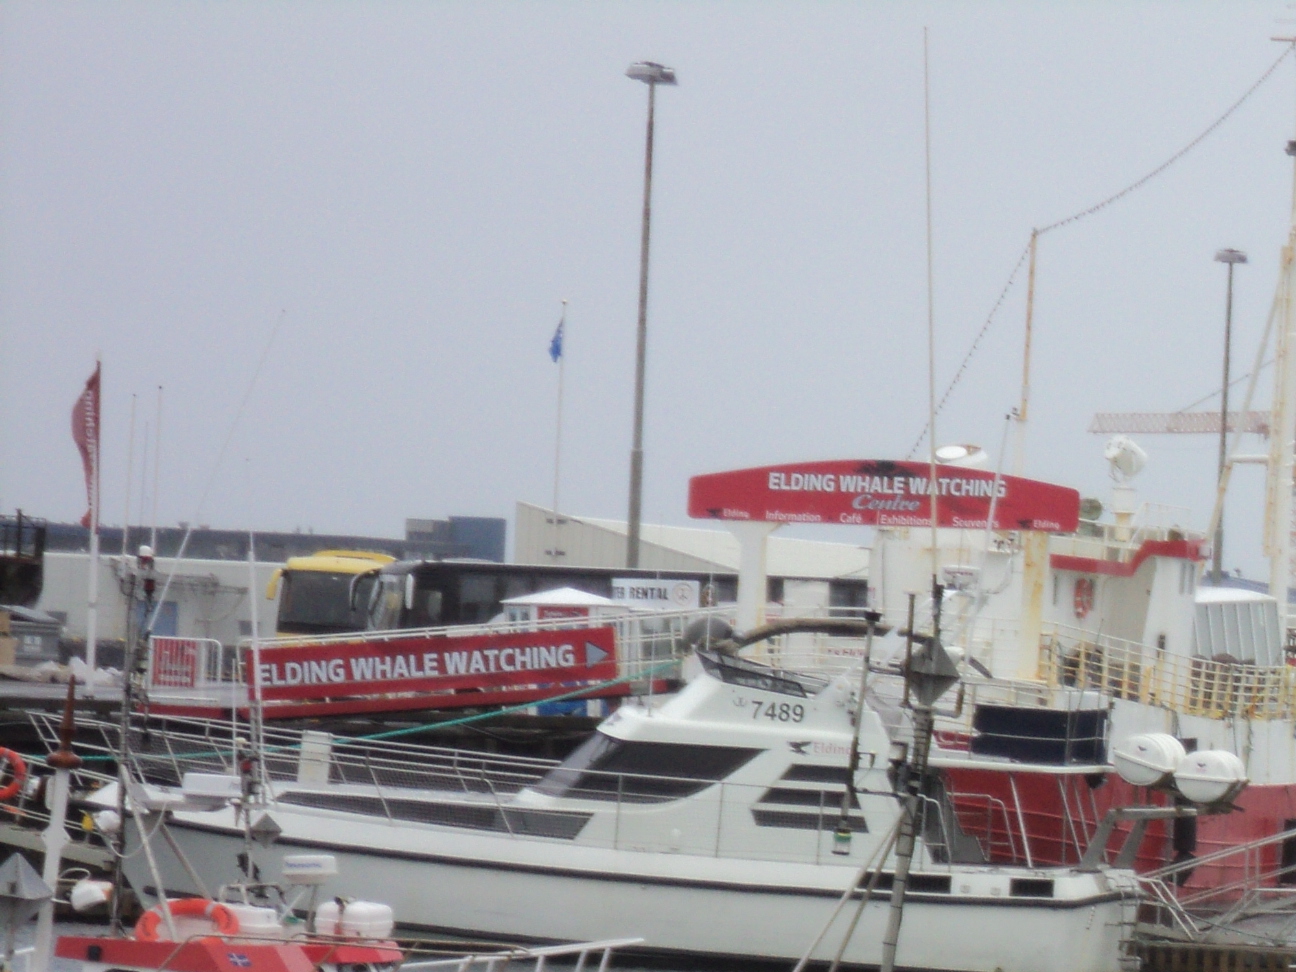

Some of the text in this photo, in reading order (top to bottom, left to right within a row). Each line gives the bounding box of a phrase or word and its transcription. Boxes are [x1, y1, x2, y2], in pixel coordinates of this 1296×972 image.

[768, 472, 1006, 498] ELDING WHALE WATCHING
[851, 494, 920, 511] Centre
[765, 510, 999, 529] Information Café Exhibitions Souvenrs
[629, 586, 668, 600] RENTAL
[259, 644, 575, 686] ELDING WHALE WATCHING
[751, 700, 805, 723] 7489
